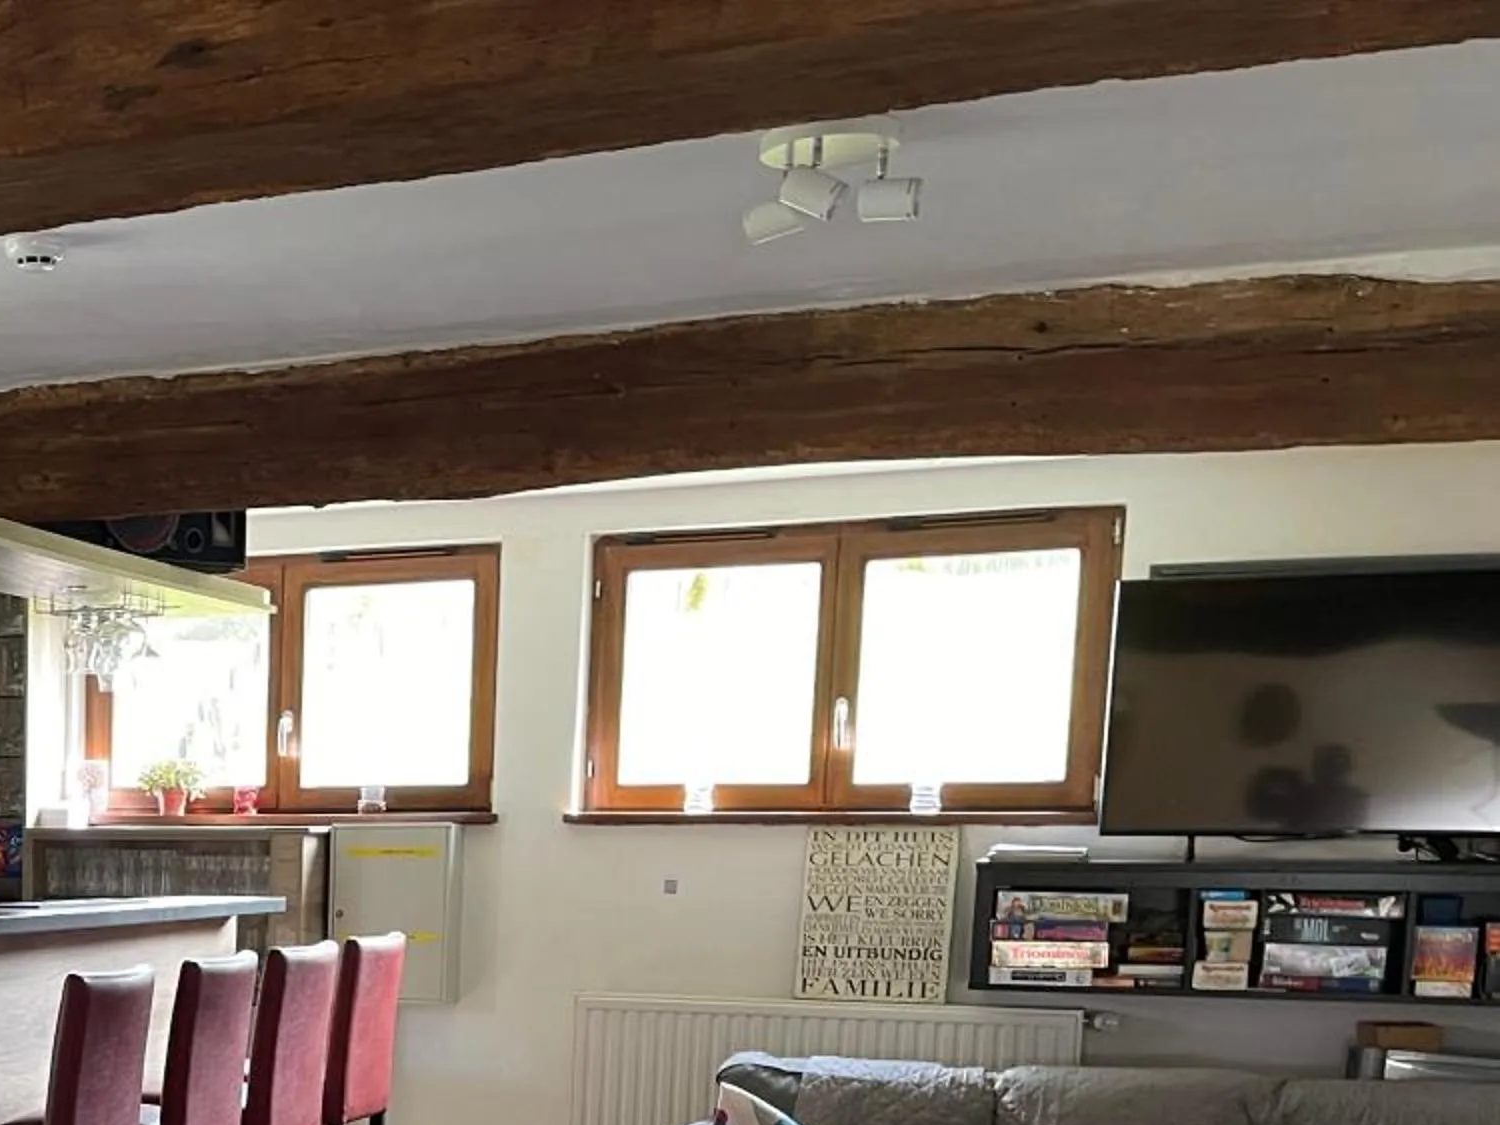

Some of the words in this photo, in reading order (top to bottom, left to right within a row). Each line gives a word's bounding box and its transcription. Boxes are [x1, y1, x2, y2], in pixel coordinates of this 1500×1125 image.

[813, 831, 836, 842] IN
[894, 831, 954, 843] HUIS
[808, 851, 950, 867] GELACHEN
[807, 895, 863, 913] WE
[888, 896, 947, 908] ZEGGEN
[894, 908, 946, 921] SORRY
[802, 945, 827, 957] EN
[833, 947, 943, 960] UITBUNDIG
[802, 978, 940, 999] FAMILIE
